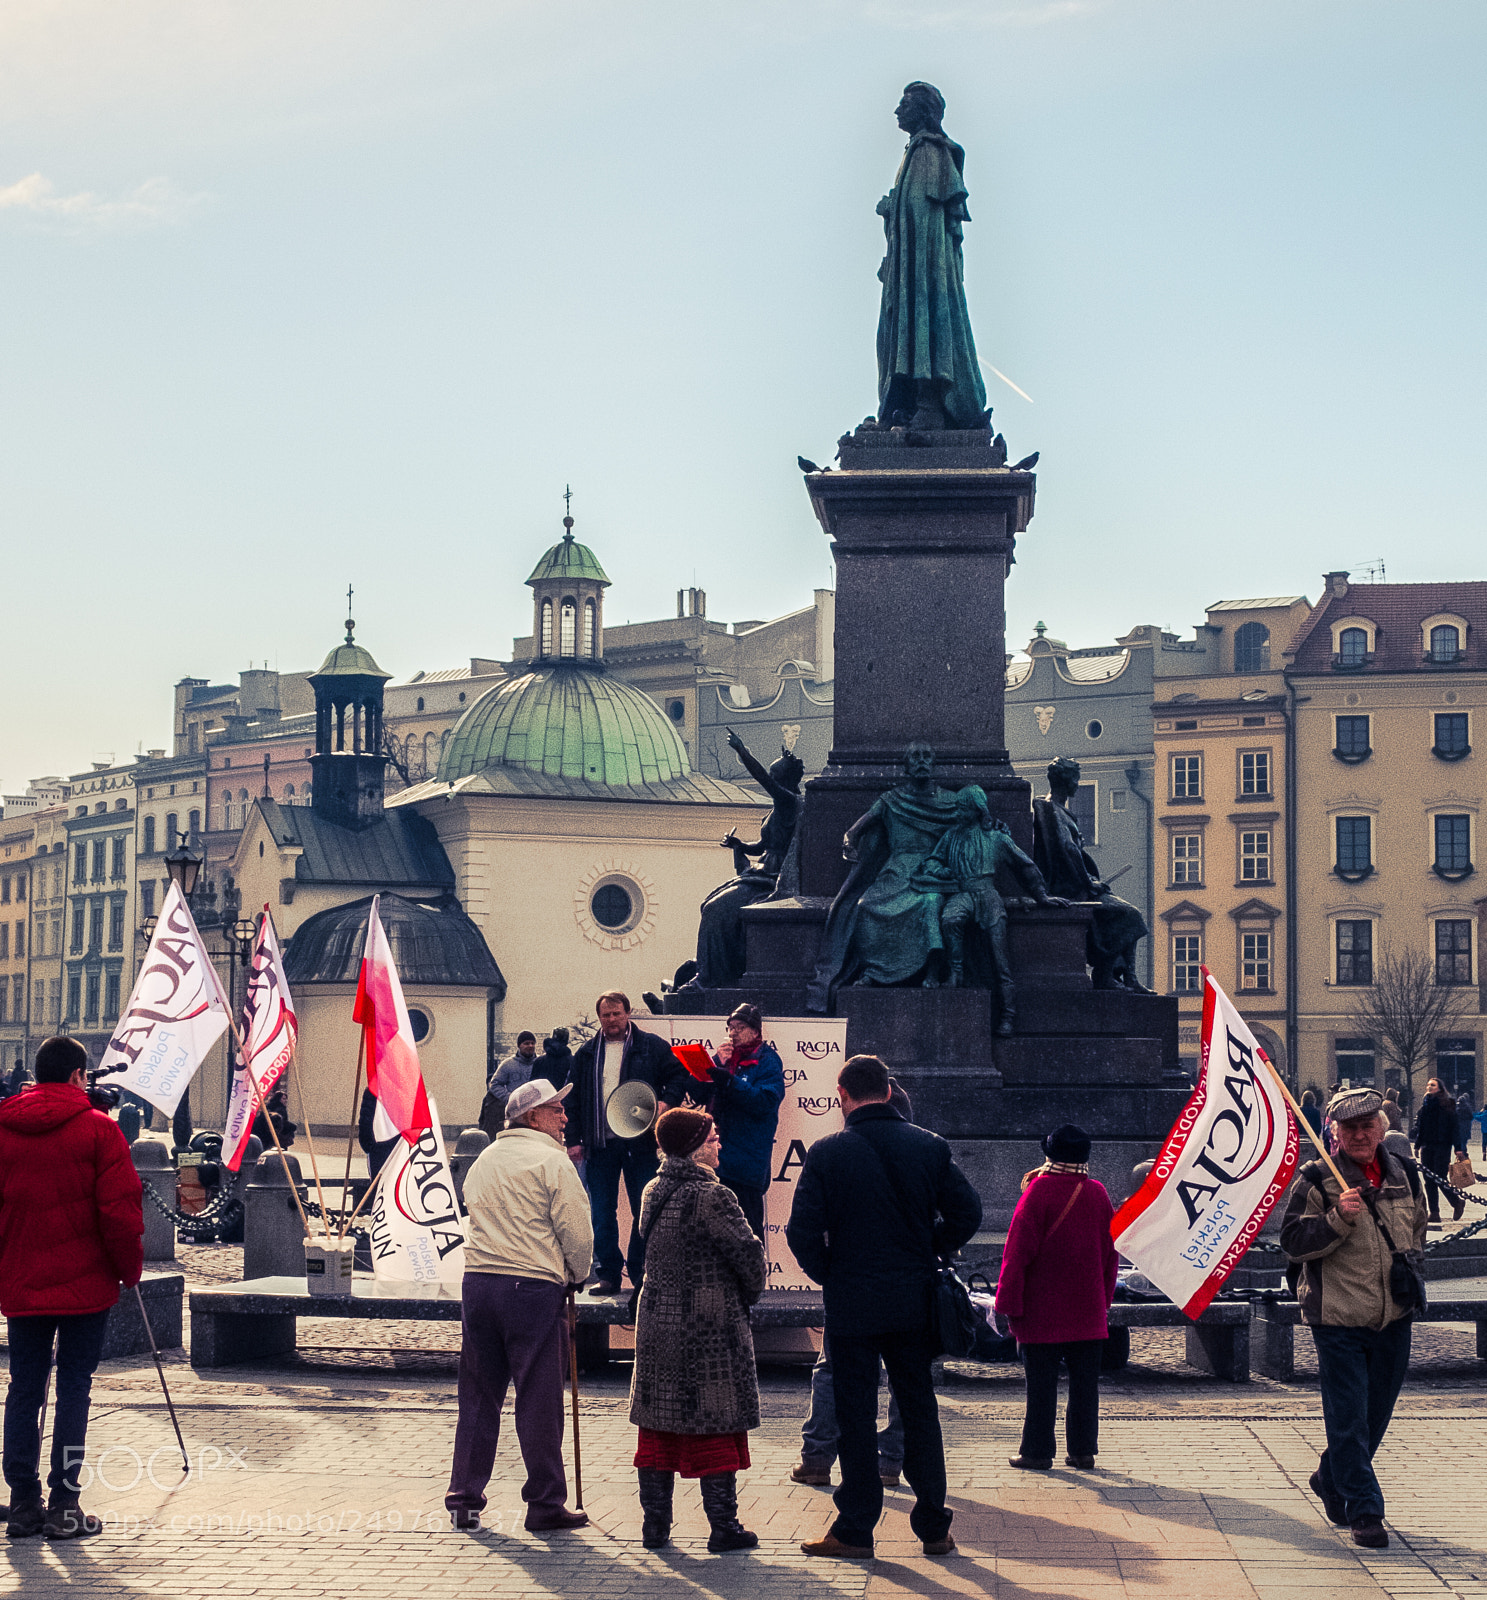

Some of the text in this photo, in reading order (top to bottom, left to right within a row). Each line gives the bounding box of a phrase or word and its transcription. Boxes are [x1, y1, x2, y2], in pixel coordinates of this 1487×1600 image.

[796, 1040, 841, 1057] RACJA
[783, 1069, 808, 1084] CJA
[797, 1096, 842, 1113] RACJA
[408, 1127, 466, 1262] RACJA
[405, 1243, 426, 1284] Lewicy
[416, 1236, 440, 1282] Polskiej
